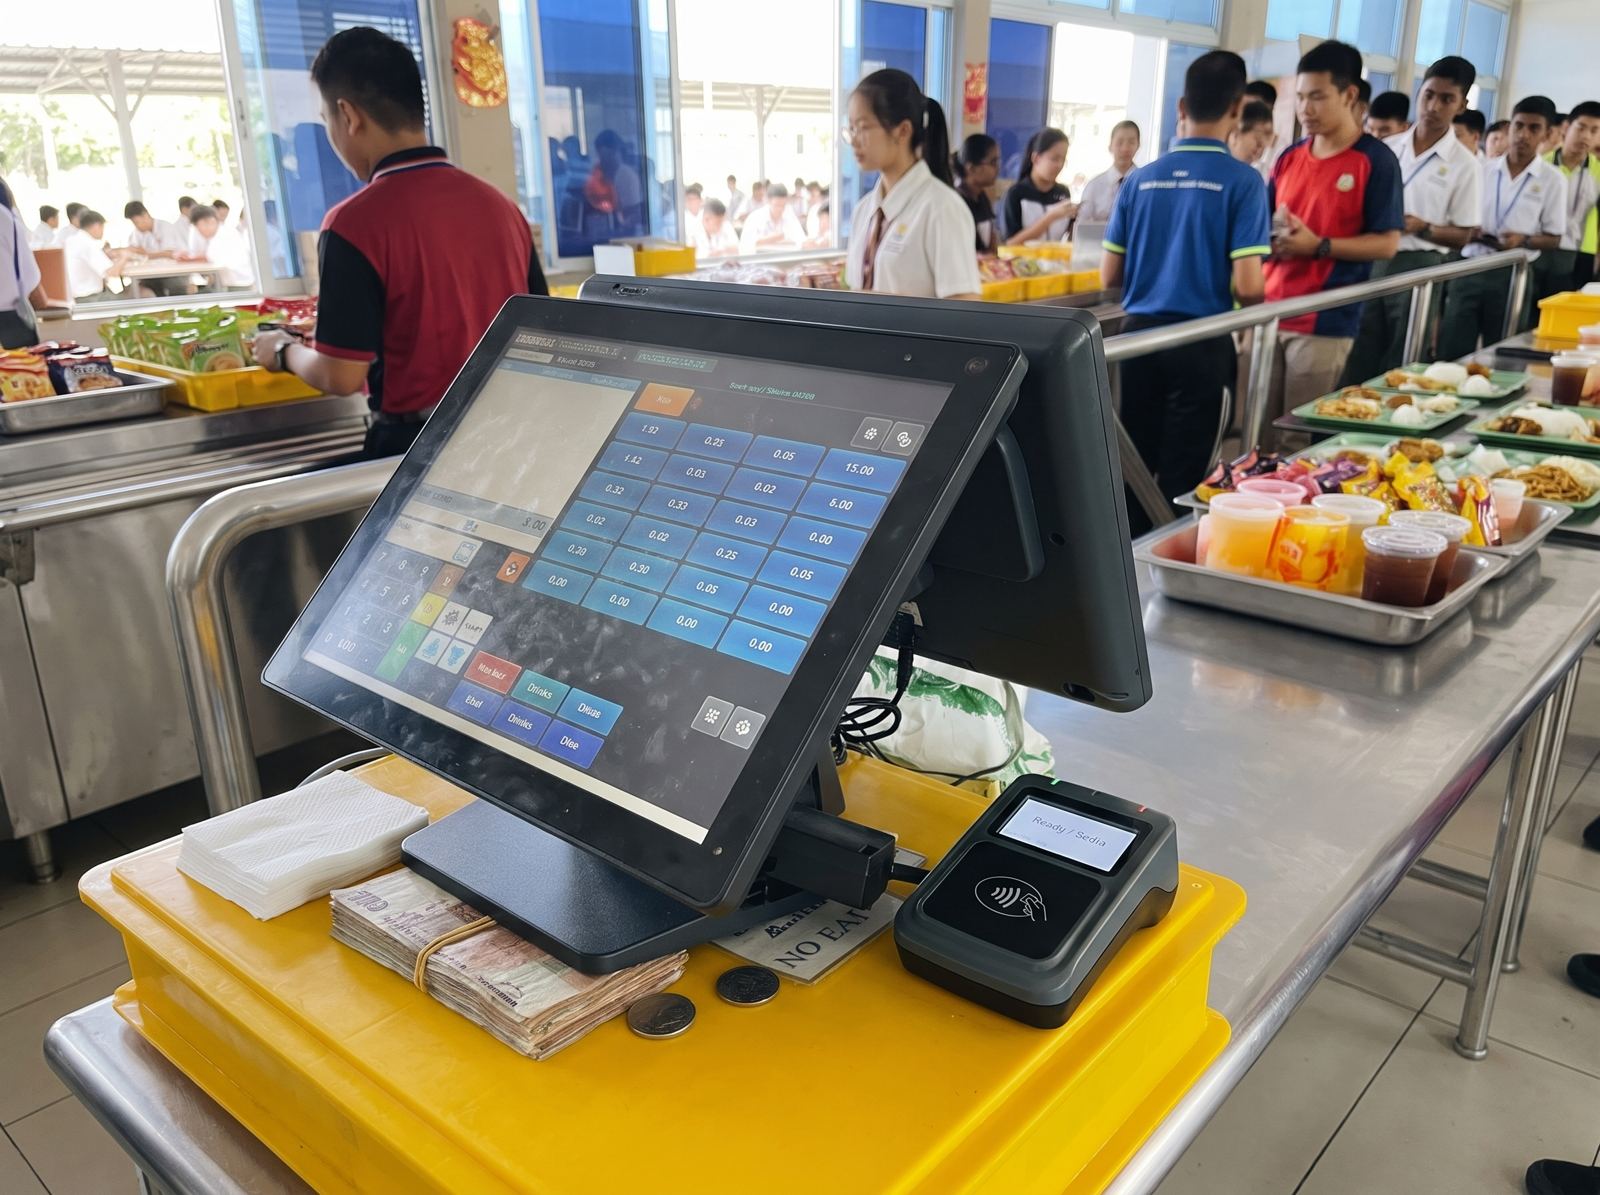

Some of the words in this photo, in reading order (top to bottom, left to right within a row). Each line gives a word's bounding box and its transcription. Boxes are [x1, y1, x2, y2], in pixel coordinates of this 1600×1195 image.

[773, 449, 796, 461] 0.05
[845, 463, 874, 476] 15.00
[686, 467, 706, 479] 0.03
[754, 482, 777, 494] 0.02
[605, 484, 625, 495] 0.32
[667, 499, 689, 511] 0.33
[734, 515, 758, 527] 0.03
[809, 532, 833, 545] 0.00
[586, 514, 606, 526] 0.02
[648, 530, 670, 542] 0.02
[715, 548, 739, 561] 0.25
[790, 567, 814, 581] 0.05
[399, 560, 408, 570] 8
[380, 586, 390, 597] 5
[402, 594, 410, 605] 6
[696, 581, 719, 595] 0.05
[768, 602, 794, 617] 0.00
[363, 615, 372, 625] 2
[383, 623, 392, 633] 3
[609, 594, 630, 608] 0.00
[676, 615, 698, 629] 0.00
[748, 638, 773, 653] 0.00
[527, 682, 553, 700] Drinks
[1032, 815, 1067, 835] Ready
[1075, 831, 1106, 847] Sedia
[774, 941, 822, 969] NO
